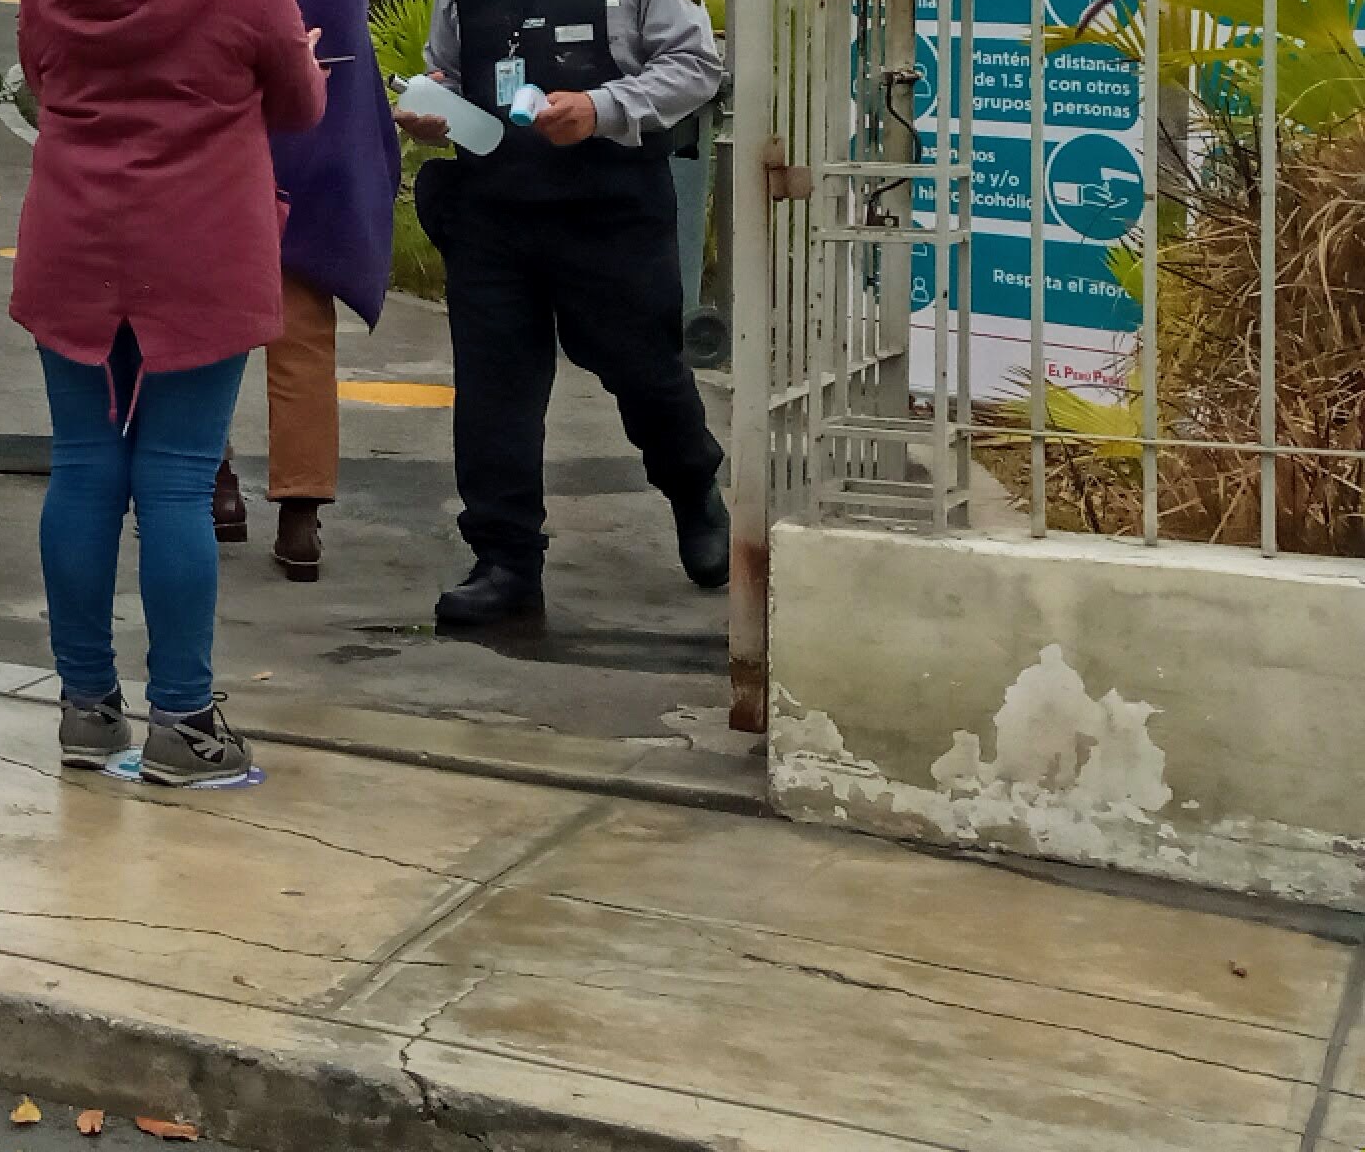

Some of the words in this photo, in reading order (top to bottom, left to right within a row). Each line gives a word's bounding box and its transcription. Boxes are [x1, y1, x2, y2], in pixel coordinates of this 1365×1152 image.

[1054, 54, 1130, 73] distancia
[974, 72, 996, 87] de
[1000, 74, 1024, 89] 1.5
[1049, 79, 1081, 93] con
[1086, 79, 1132, 97] otros
[1053, 102, 1131, 119] personas
[988, 170, 1020, 188] y/o
[993, 269, 1062, 291] Respta
[1067, 279, 1084, 293] el
